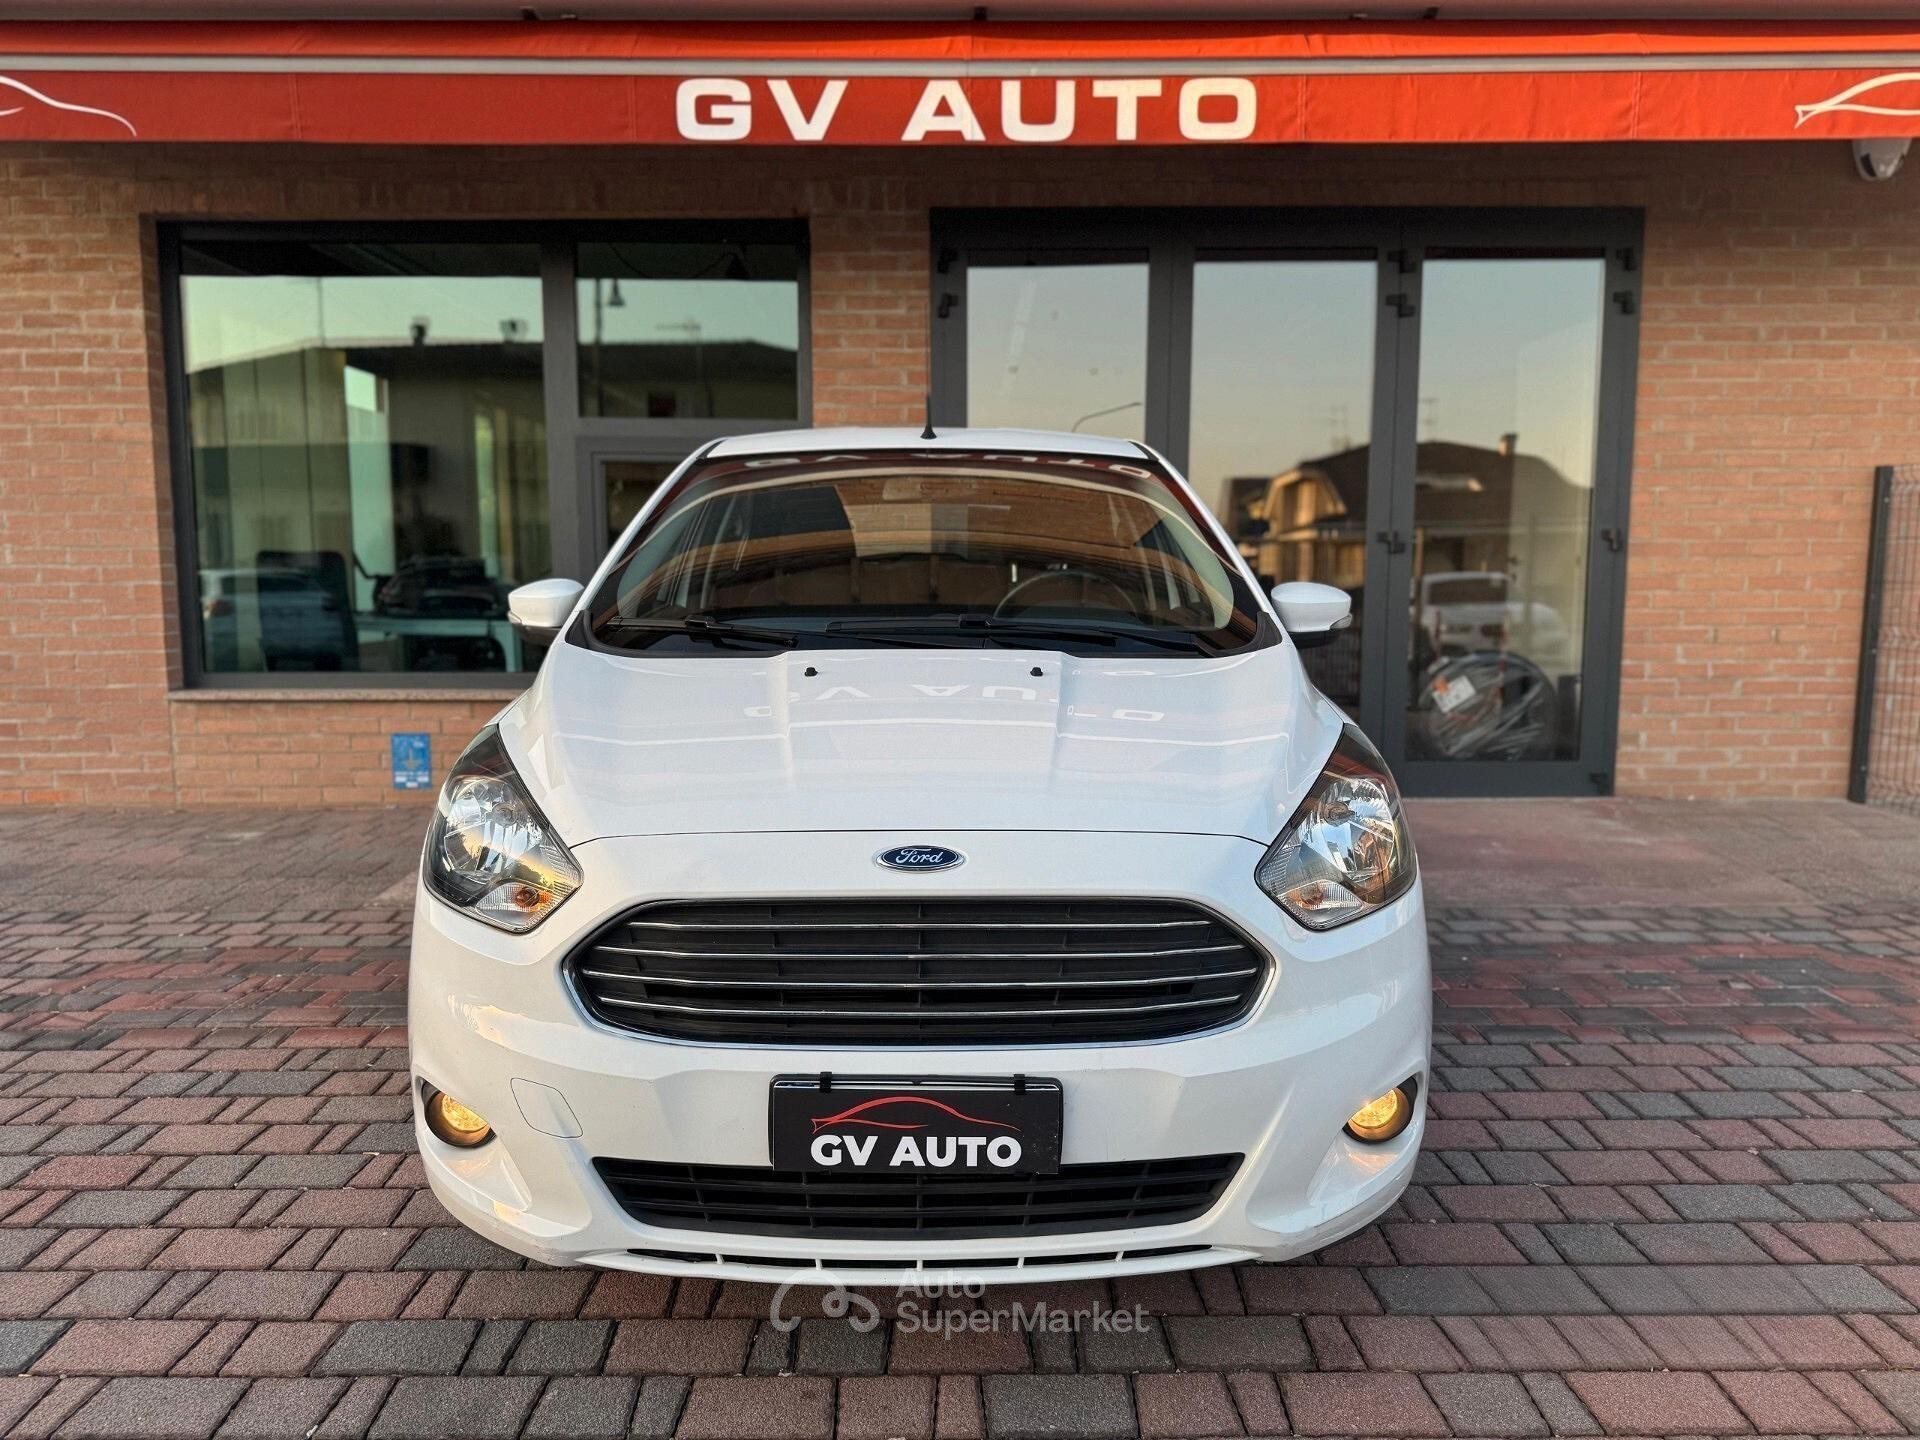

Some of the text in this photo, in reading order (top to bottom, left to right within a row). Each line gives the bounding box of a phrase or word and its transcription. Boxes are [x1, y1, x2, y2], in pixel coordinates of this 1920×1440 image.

[675, 77, 1258, 142] GV AUTO
[895, 848, 944, 864] Ford
[810, 1134, 1022, 1168] GV AUTO
